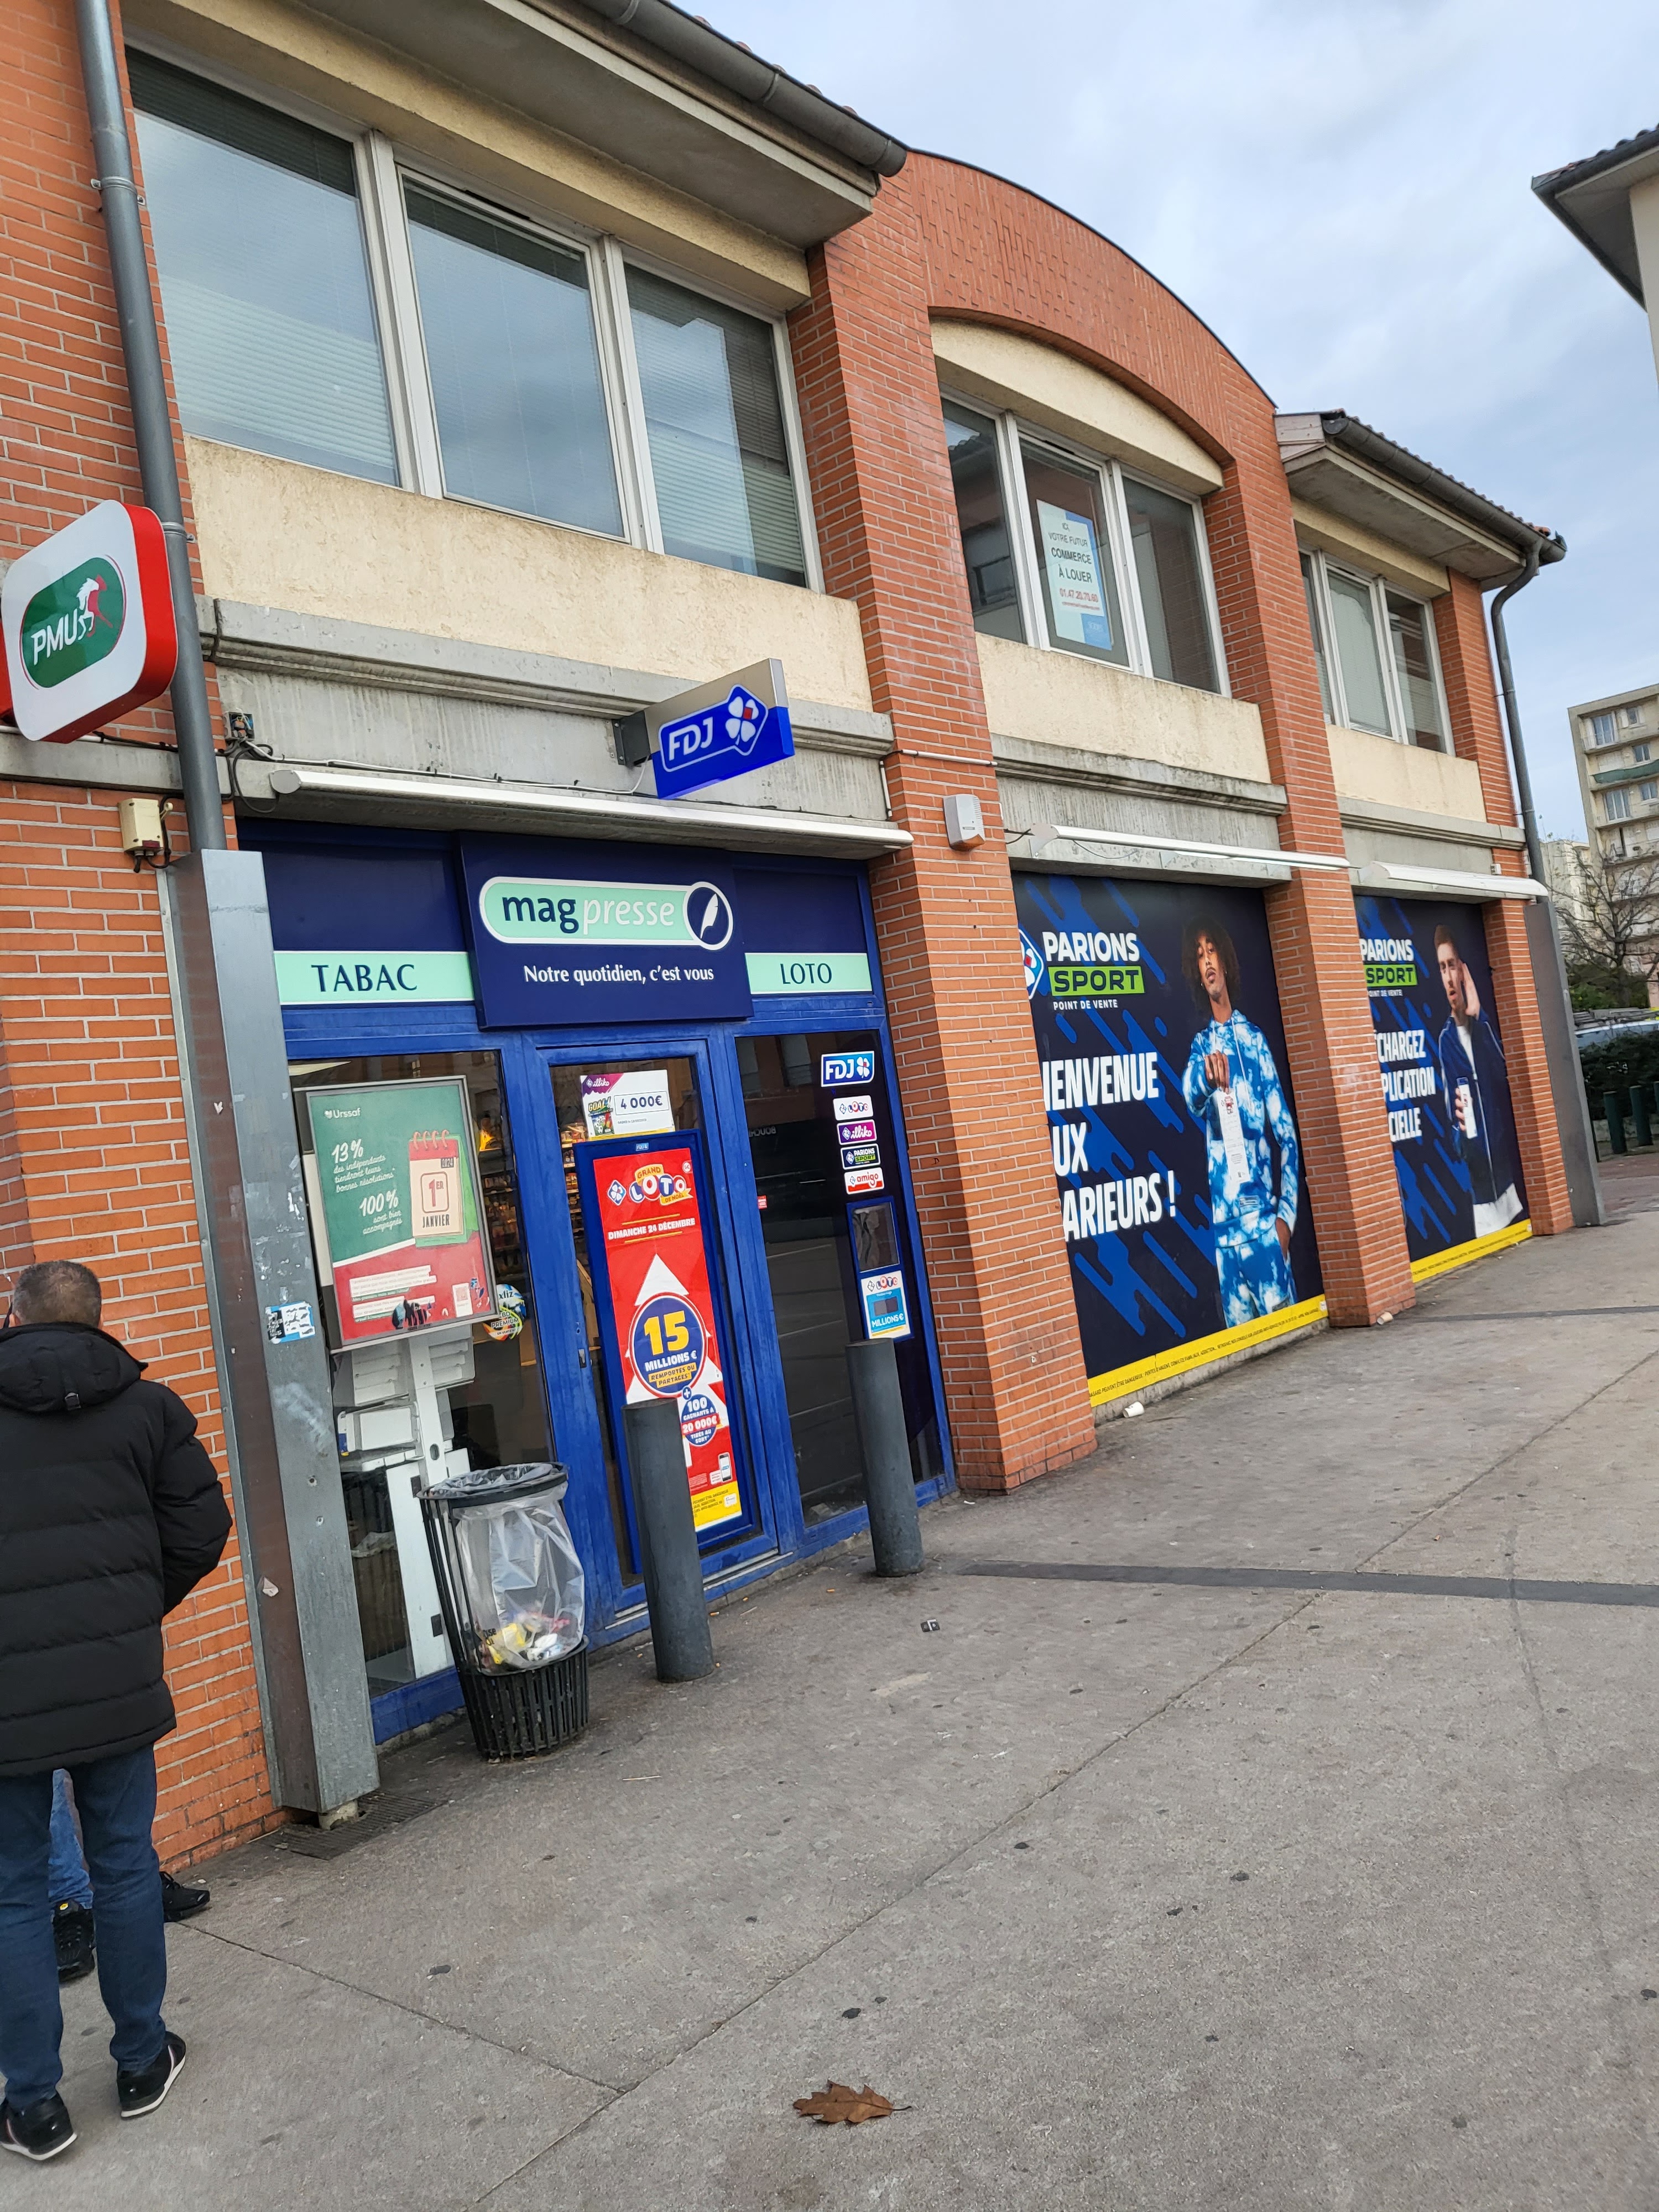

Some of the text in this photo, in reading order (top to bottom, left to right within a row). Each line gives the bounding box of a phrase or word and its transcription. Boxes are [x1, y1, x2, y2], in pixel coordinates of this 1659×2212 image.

[1070, 536, 1088, 547] FUTUR
[1051, 547, 1092, 565] COMMERCE
[1065, 567, 1092, 583] LOUER
[30, 608, 79, 666] PMU
[669, 717, 713, 761] FDJ
[1042, 931, 1140, 962] PARIONS
[1359, 938, 1414, 962] PARIONS
[311, 964, 418, 992] TABAC
[524, 964, 714, 985] Notre quotidien, c'est vous
[780, 963, 832, 984] LOTO
[1365, 967, 1413, 984] SPORT
[1053, 970, 1139, 993] SPORT
[1053, 999, 1119, 1011] POINT DE VENTE
[826, 1058, 854, 1080] FDJ
[592, 1078, 610, 1087] illiko
[620, 1098, 627, 1109] 4
[848, 1100, 869, 1113] LOTO
[333, 1108, 361, 1118] Urssaf
[851, 1125, 873, 1139] illiko
[854, 1147, 875, 1156] PARIONS
[334, 1165, 345, 1174] des
[441, 1158, 453, 1167] 2024
[335, 1166, 381, 1183] tiendront leurs
[637, 1166, 661, 1179] GRAND
[857, 1171, 879, 1187] amigo
[336, 1182, 358, 1193] bonnes
[630, 1175, 686, 1201] LOTO
[422, 1214, 450, 1228] JANVIER
[608, 1218, 696, 1240] DIMANCHE 24 DÉCEMBRE
[876, 1276, 898, 1290] LOTO
[491, 1318, 519, 1328] PREMIUM
[872, 1314, 899, 1328] MILLIONS
[644, 1310, 689, 1356] 15
[645, 1350, 697, 1372] MILLIONS €
[687, 1397, 707, 1412] 100
[683, 1408, 709, 1421] GAGNANTS
[682, 1422, 694, 1434] 20
